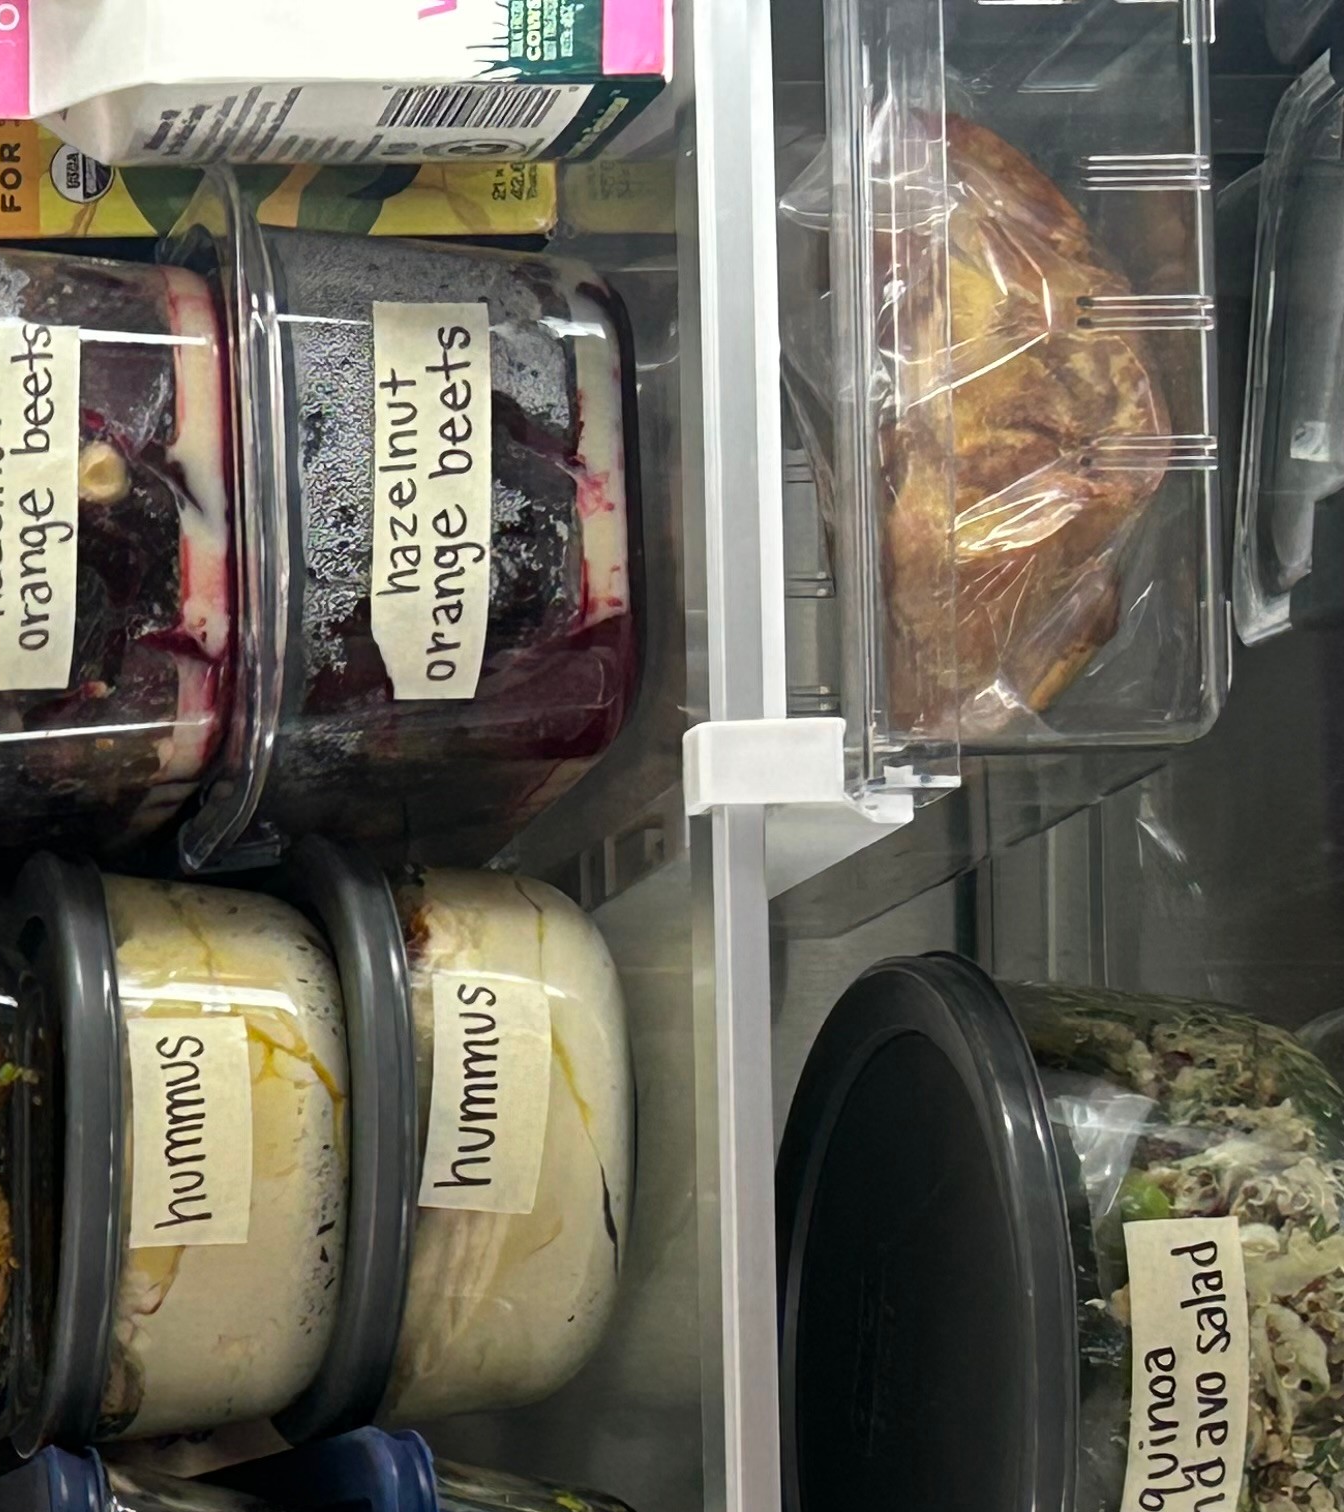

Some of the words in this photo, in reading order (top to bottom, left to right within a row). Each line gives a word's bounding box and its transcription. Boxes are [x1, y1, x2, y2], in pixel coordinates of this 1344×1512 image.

[0, 142, 22, 213] FOR
[9, 322, 55, 455] beets
[424, 325, 474, 479] beets
[377, 366, 422, 596] hazelnut
[15, 486, 74, 652] orange
[424, 504, 486, 682] orange
[153, 1034, 213, 1229] hummus
[432, 982, 500, 1189] hummus
[1170, 1240, 1232, 1355] salad
[1137, 1346, 1196, 1512] quinoa
[1194, 1371, 1230, 1447] avo
